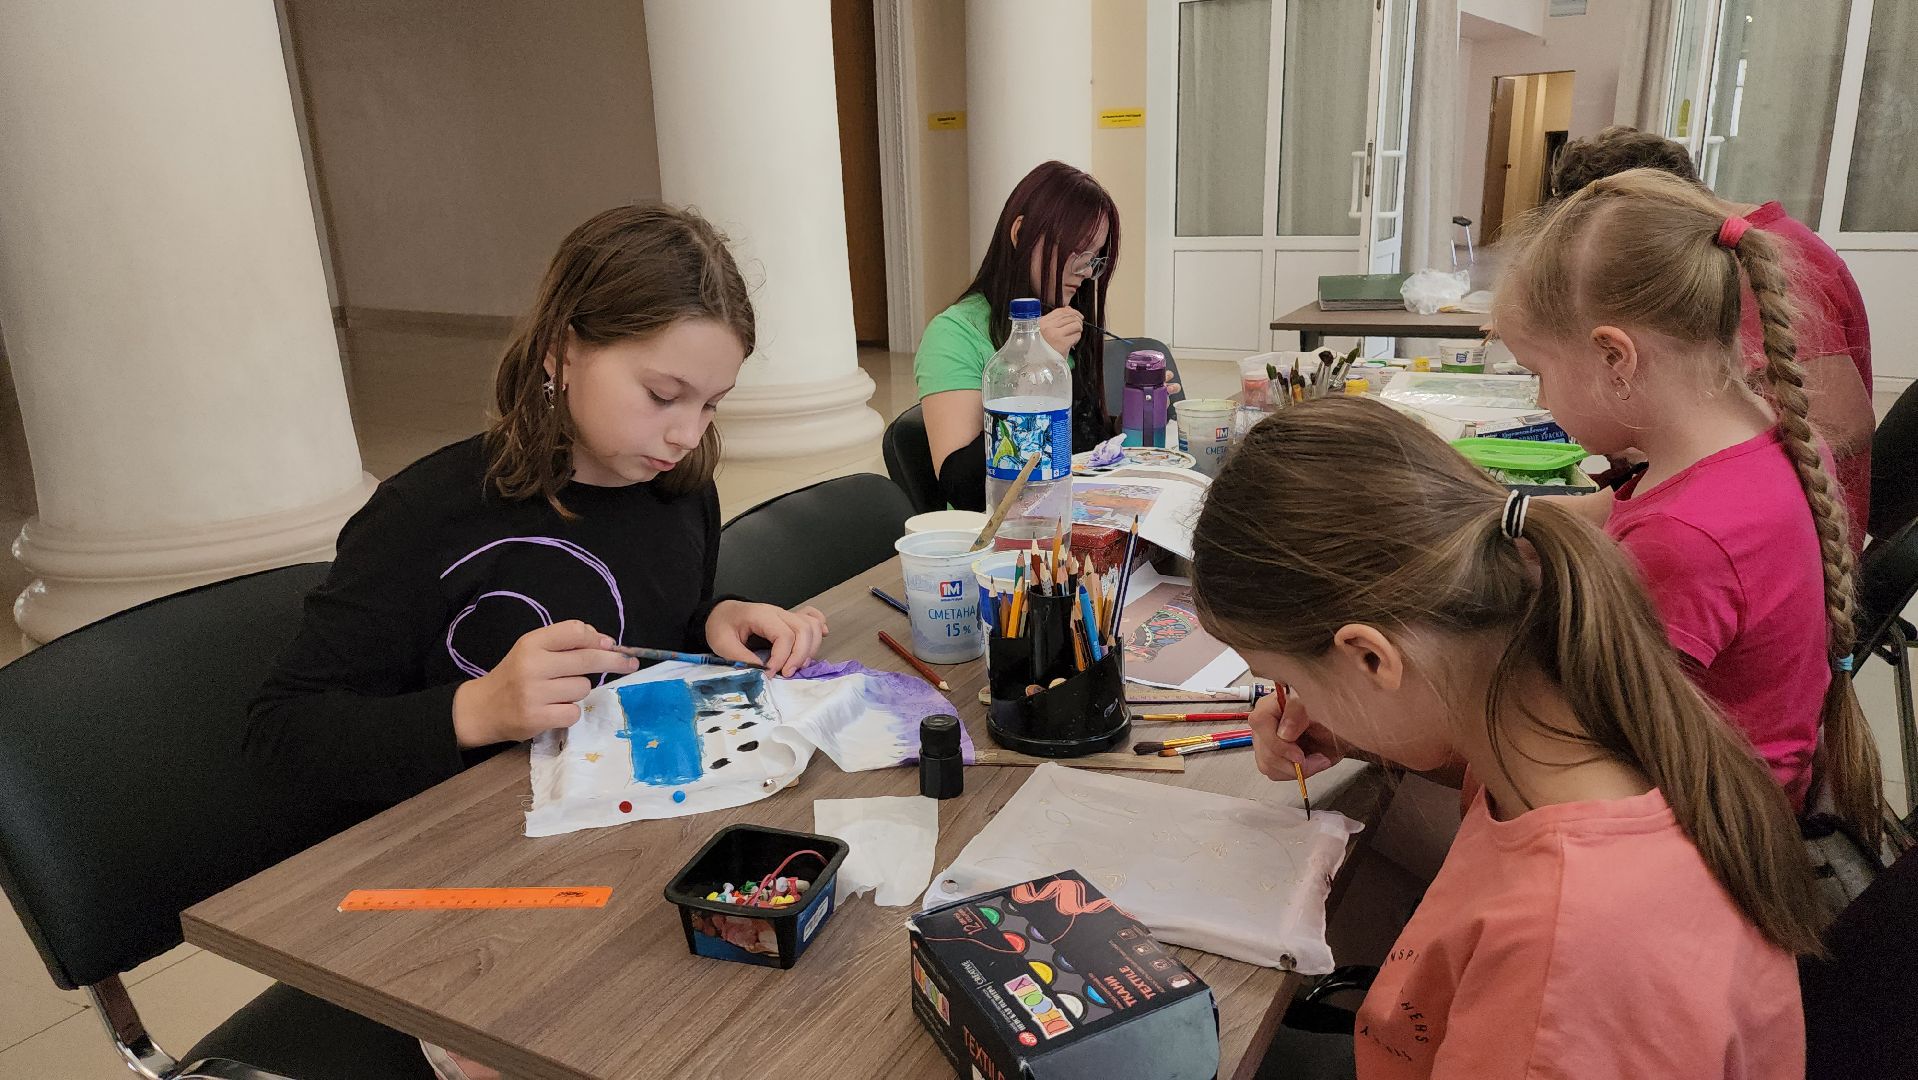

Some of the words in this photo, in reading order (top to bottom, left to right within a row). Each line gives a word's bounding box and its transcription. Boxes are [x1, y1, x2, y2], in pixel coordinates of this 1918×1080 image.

[928, 605, 976, 620] СМЕТАНА
[946, 623, 961, 637] 15
[963, 624, 971, 634] %
[1104, 974, 1138, 1007] ТКАНИ
[1118, 965, 1157, 999] TEXTILE
